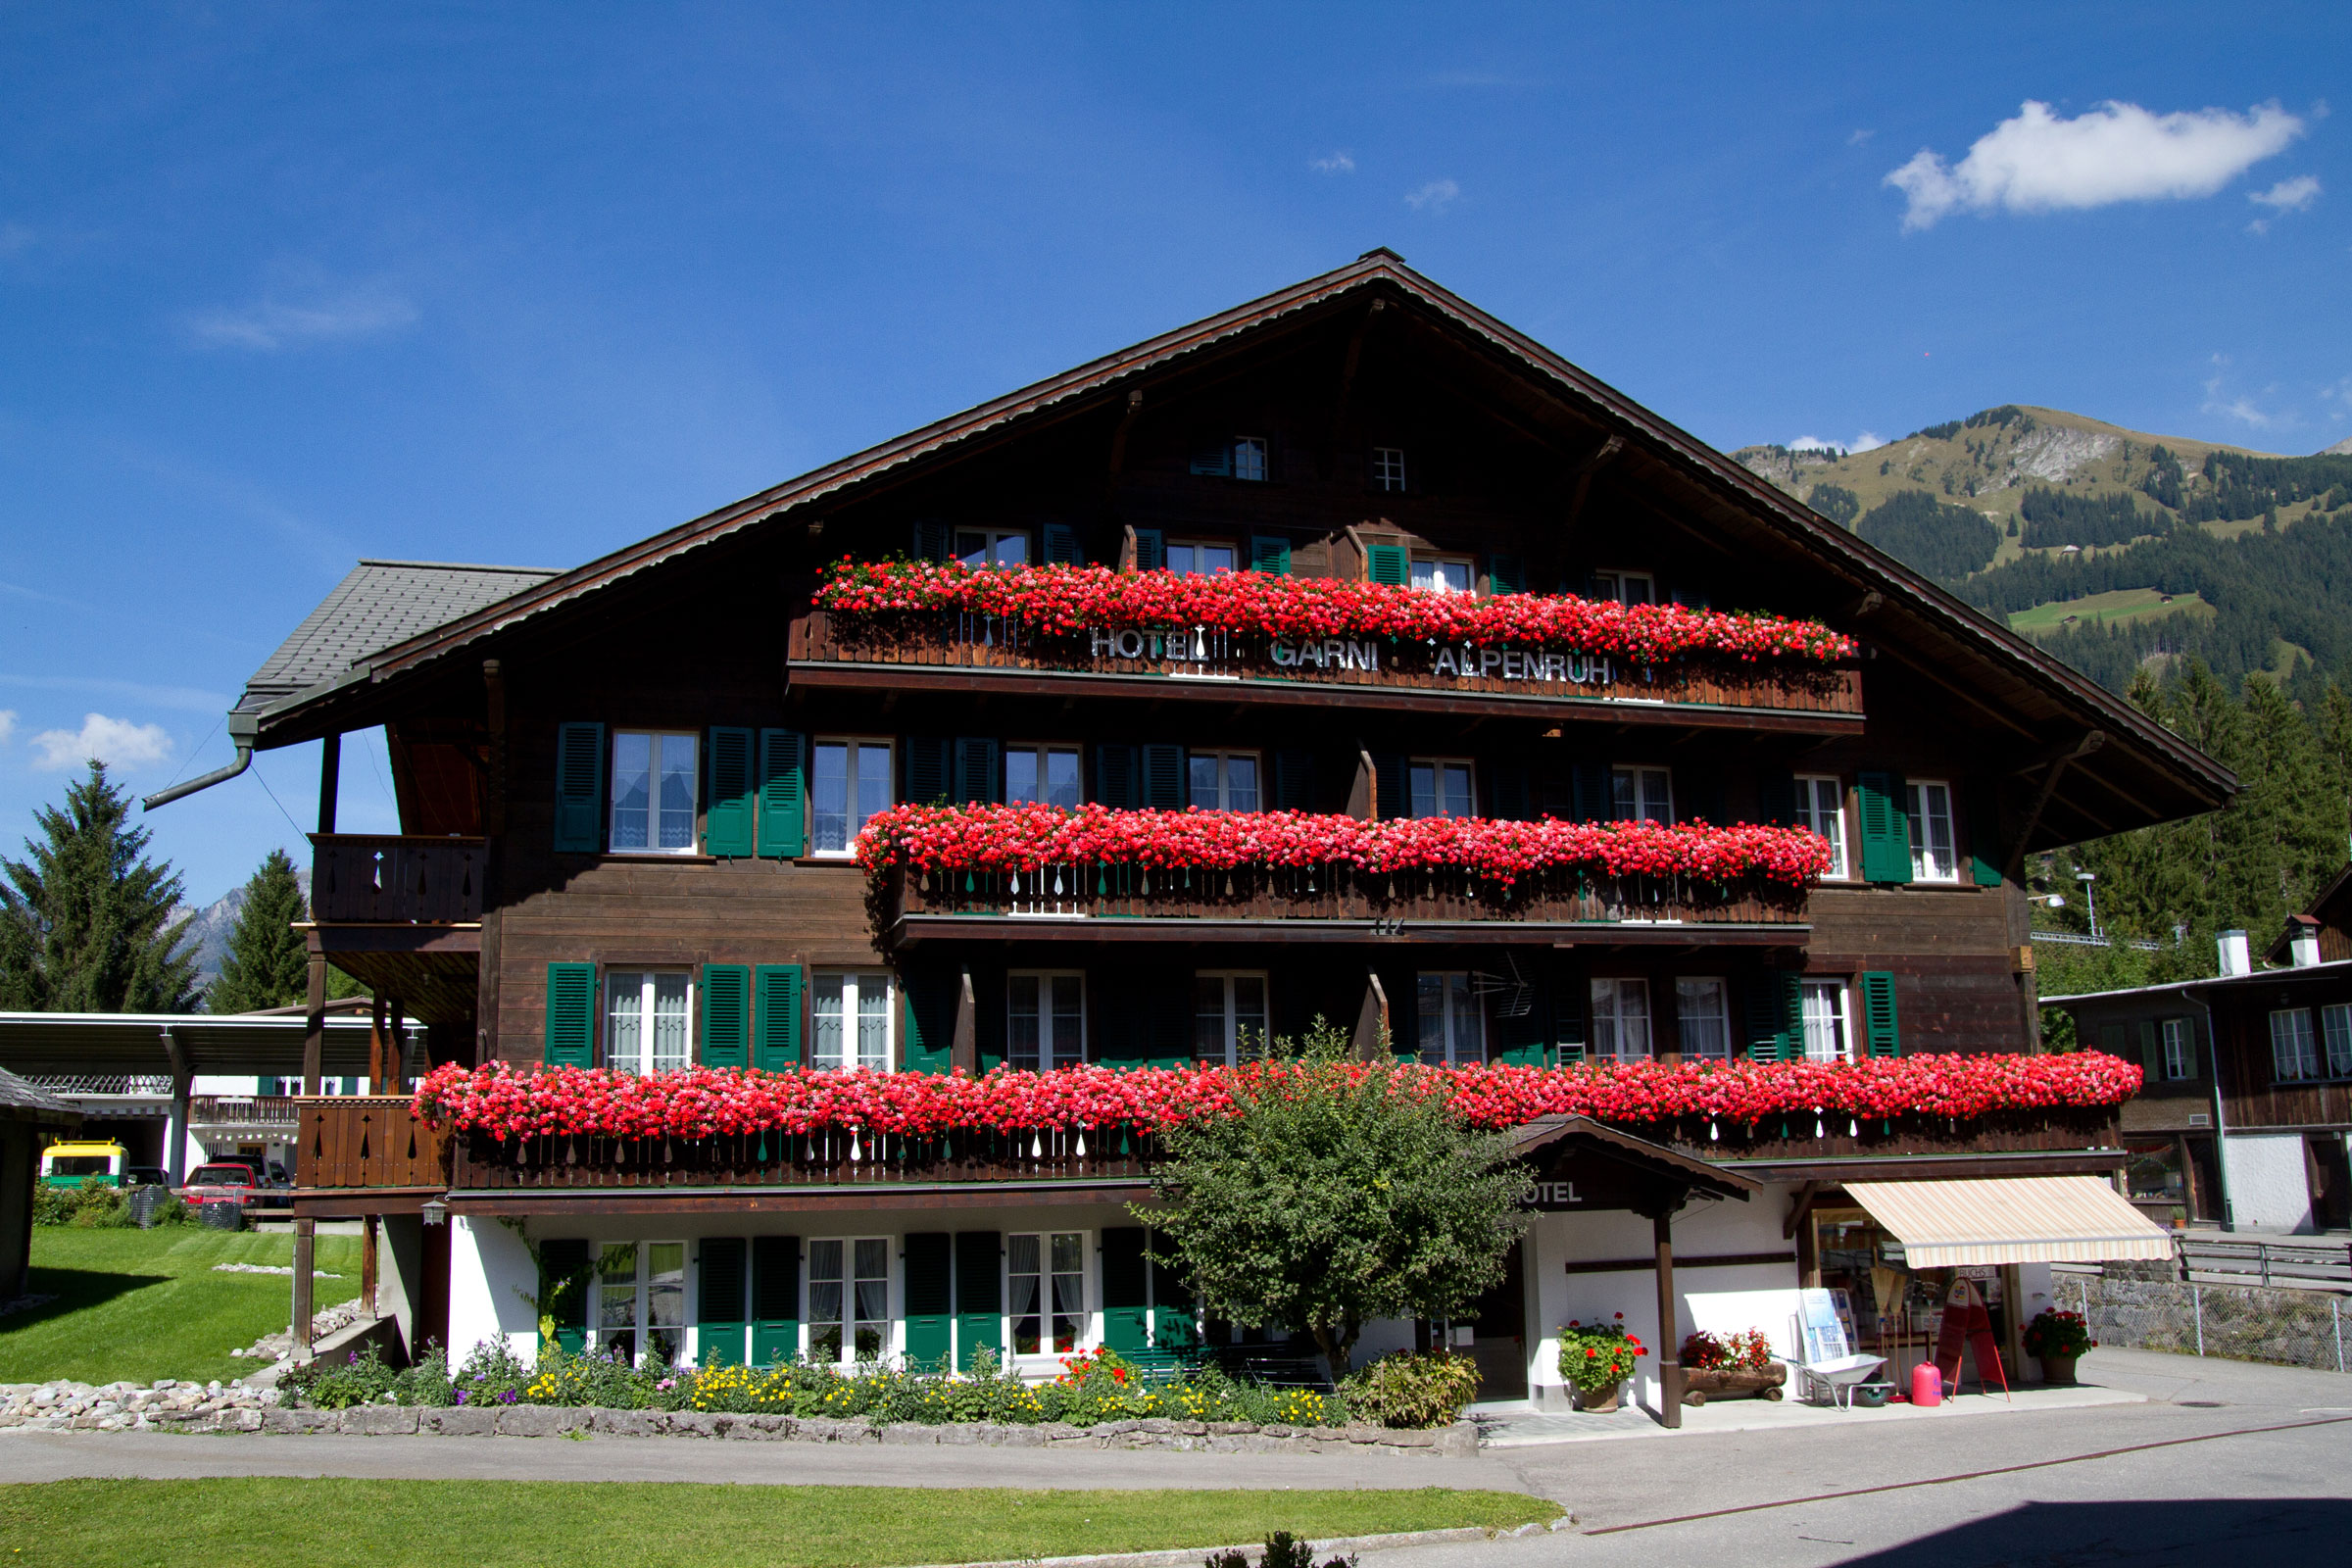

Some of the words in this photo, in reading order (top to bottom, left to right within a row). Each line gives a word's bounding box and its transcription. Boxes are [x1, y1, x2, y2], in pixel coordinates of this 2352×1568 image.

[1091, 626, 1209, 662] HOTEL
[1270, 638, 1378, 671] GARNI
[1434, 647, 1610, 685] ALPENRUH
